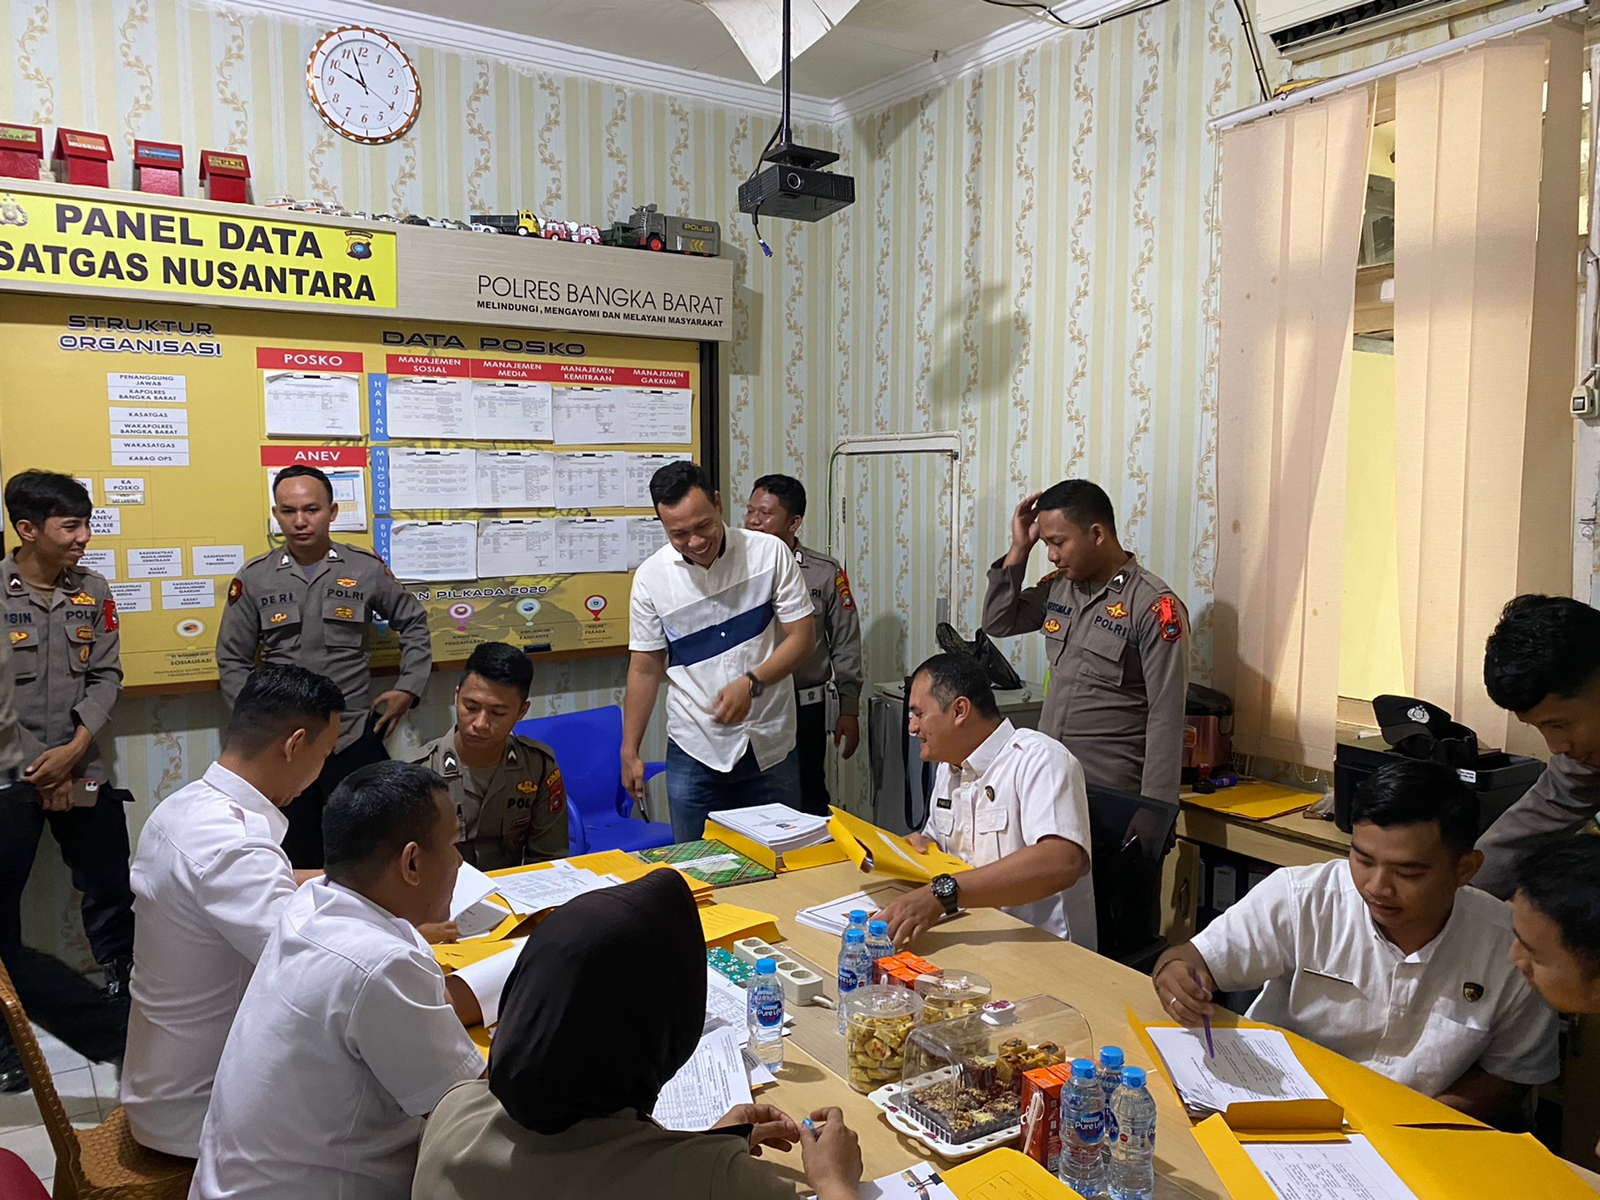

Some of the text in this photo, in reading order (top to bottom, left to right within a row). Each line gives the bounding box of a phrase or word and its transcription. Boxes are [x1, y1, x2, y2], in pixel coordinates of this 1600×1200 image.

[342, 49, 351, 59] 11
[358, 47, 368, 58] 12
[376, 54, 381, 64] 1
[330, 59, 340, 70] 10
[387, 68, 394, 78] 2
[328, 76, 335, 85] 9
[392, 85, 399, 95] 3
[332, 93, 339, 103] 8
[389, 102, 395, 111] 4
[346, 107, 352, 117] 7
[377, 112, 384, 121] 5
[361, 114, 368, 123] 6
[68, 141, 107, 152] MUSEUM
[220, 158, 243, 168] PLN
[56, 204, 323, 259] PANEL DATA
[684, 222, 713, 233] POLISI
[0, 240, 375, 301] SATGAS NUSANTARA
[478, 275, 723, 315] POLRES BANGKA BARAT
[544, 306, 600, 318] MENGAYOMI
[602, 311, 622, 320] DAN
[623, 313, 666, 324] MELAYANI
[668, 315, 723, 328] MASYARAKAT
[68, 315, 213, 336] STRUKTUR
[60, 335, 222, 356] ORGANISASI
[382, 331, 586, 357] DATA POSKO
[284, 354, 343, 366] POSKO
[398, 356, 461, 366] MANAJEMEN
[413, 365, 447, 374] SOSIAL
[483, 361, 542, 370] MANAJEMEN
[561, 365, 615, 375] MANAJEMEN
[564, 373, 612, 382] KEMITRAAN
[633, 369, 684, 378] MANAJEMEN
[641, 377, 676, 385] GAKKUM
[374, 380, 384, 434] HARIAN
[294, 451, 340, 461] ANEV
[376, 450, 386, 511] MINGGUAN
[327, 588, 364, 600] POLRI
[436, 588, 505, 599] PILKADA
[510, 586, 547, 594] 2020
[1094, 616, 1128, 636] POLRI
[1075, 1121, 1094, 1130] Pure
